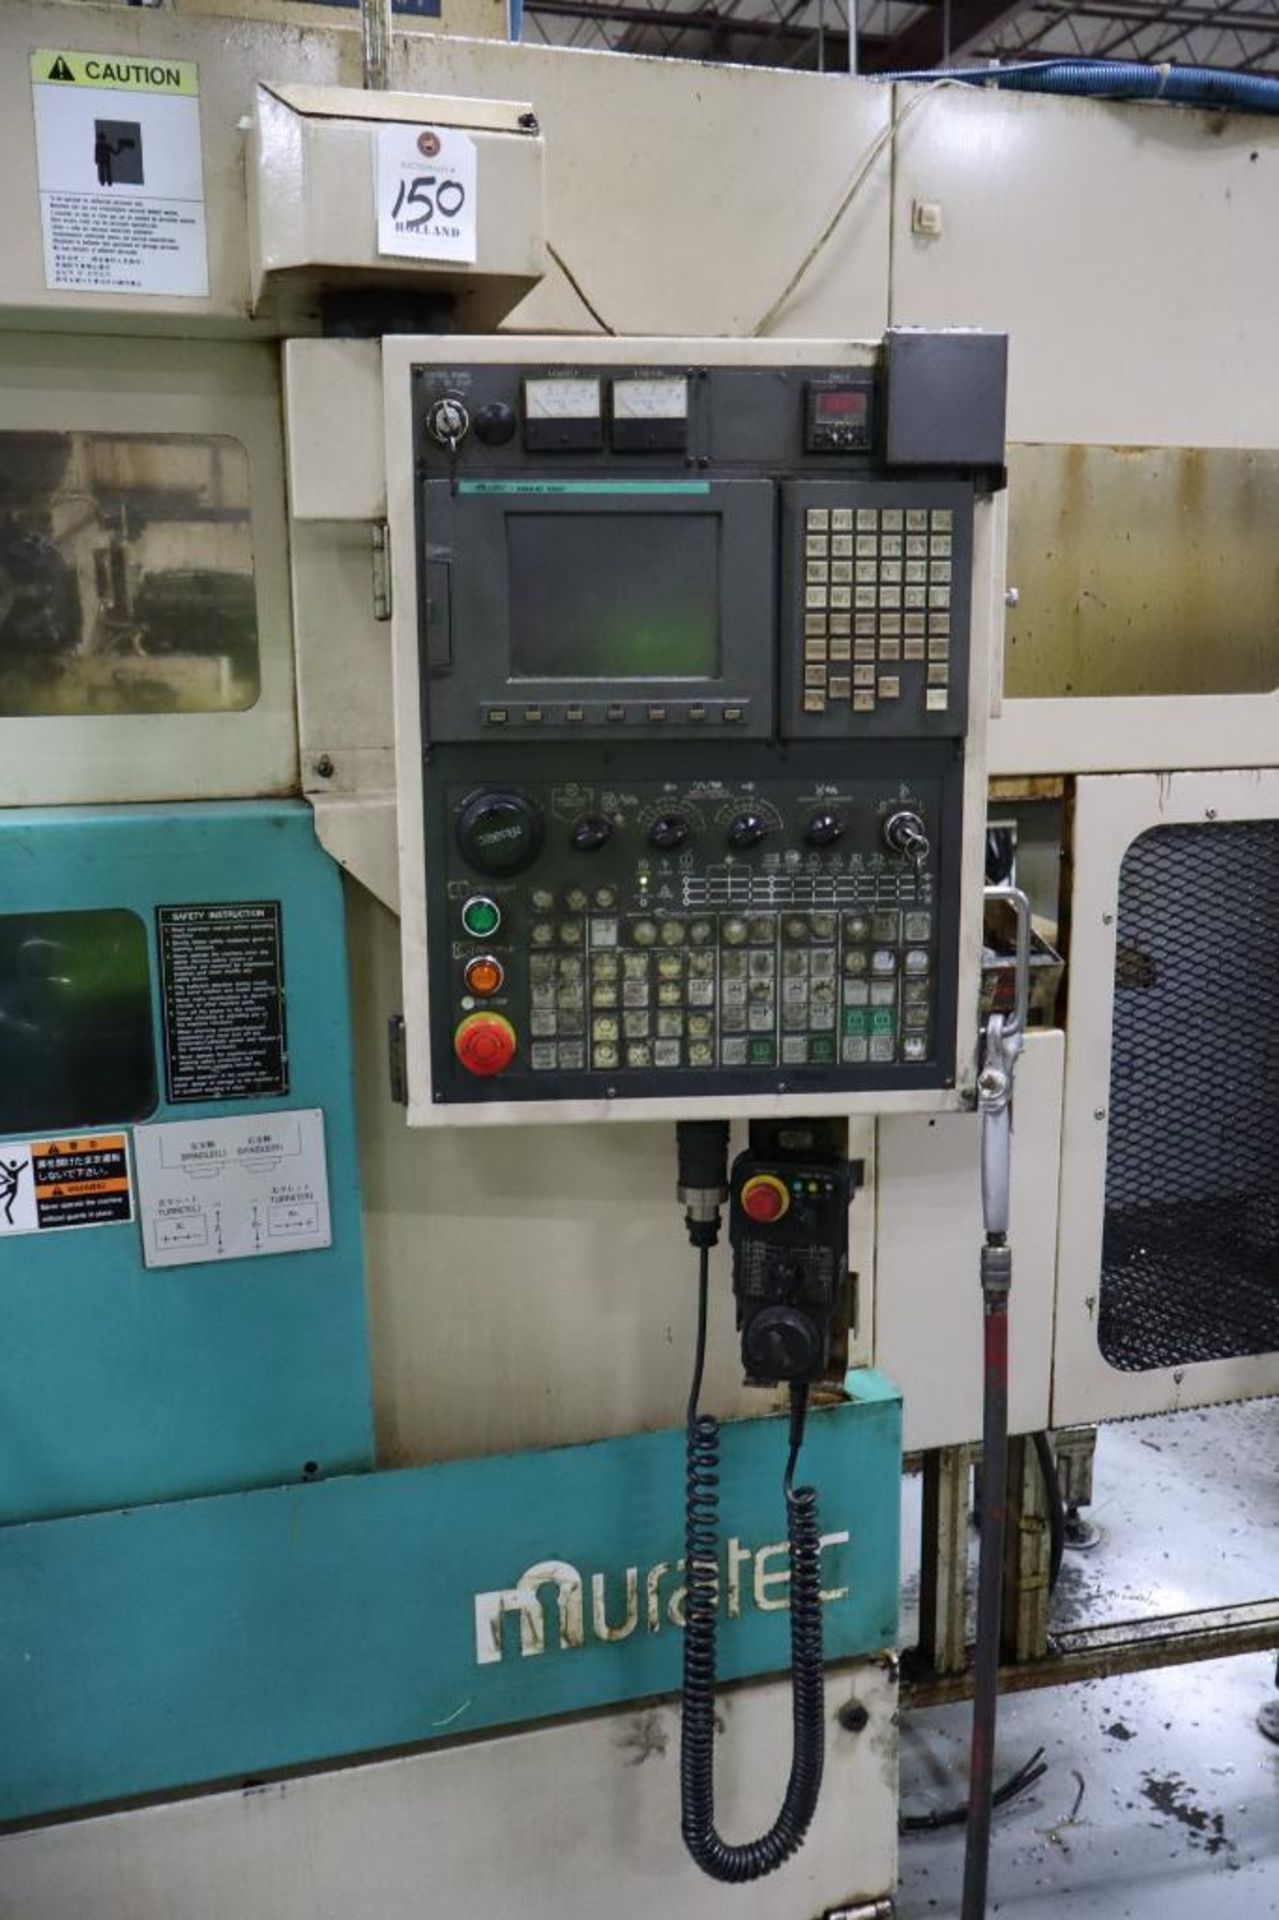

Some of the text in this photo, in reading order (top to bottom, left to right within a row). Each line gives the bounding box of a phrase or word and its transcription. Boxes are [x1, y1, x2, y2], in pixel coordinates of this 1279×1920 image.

[85, 61, 181, 86] CAUTION
[391, 176, 465, 229] 150
[172, 909, 265, 921] SAFETY INSTRUCTION
